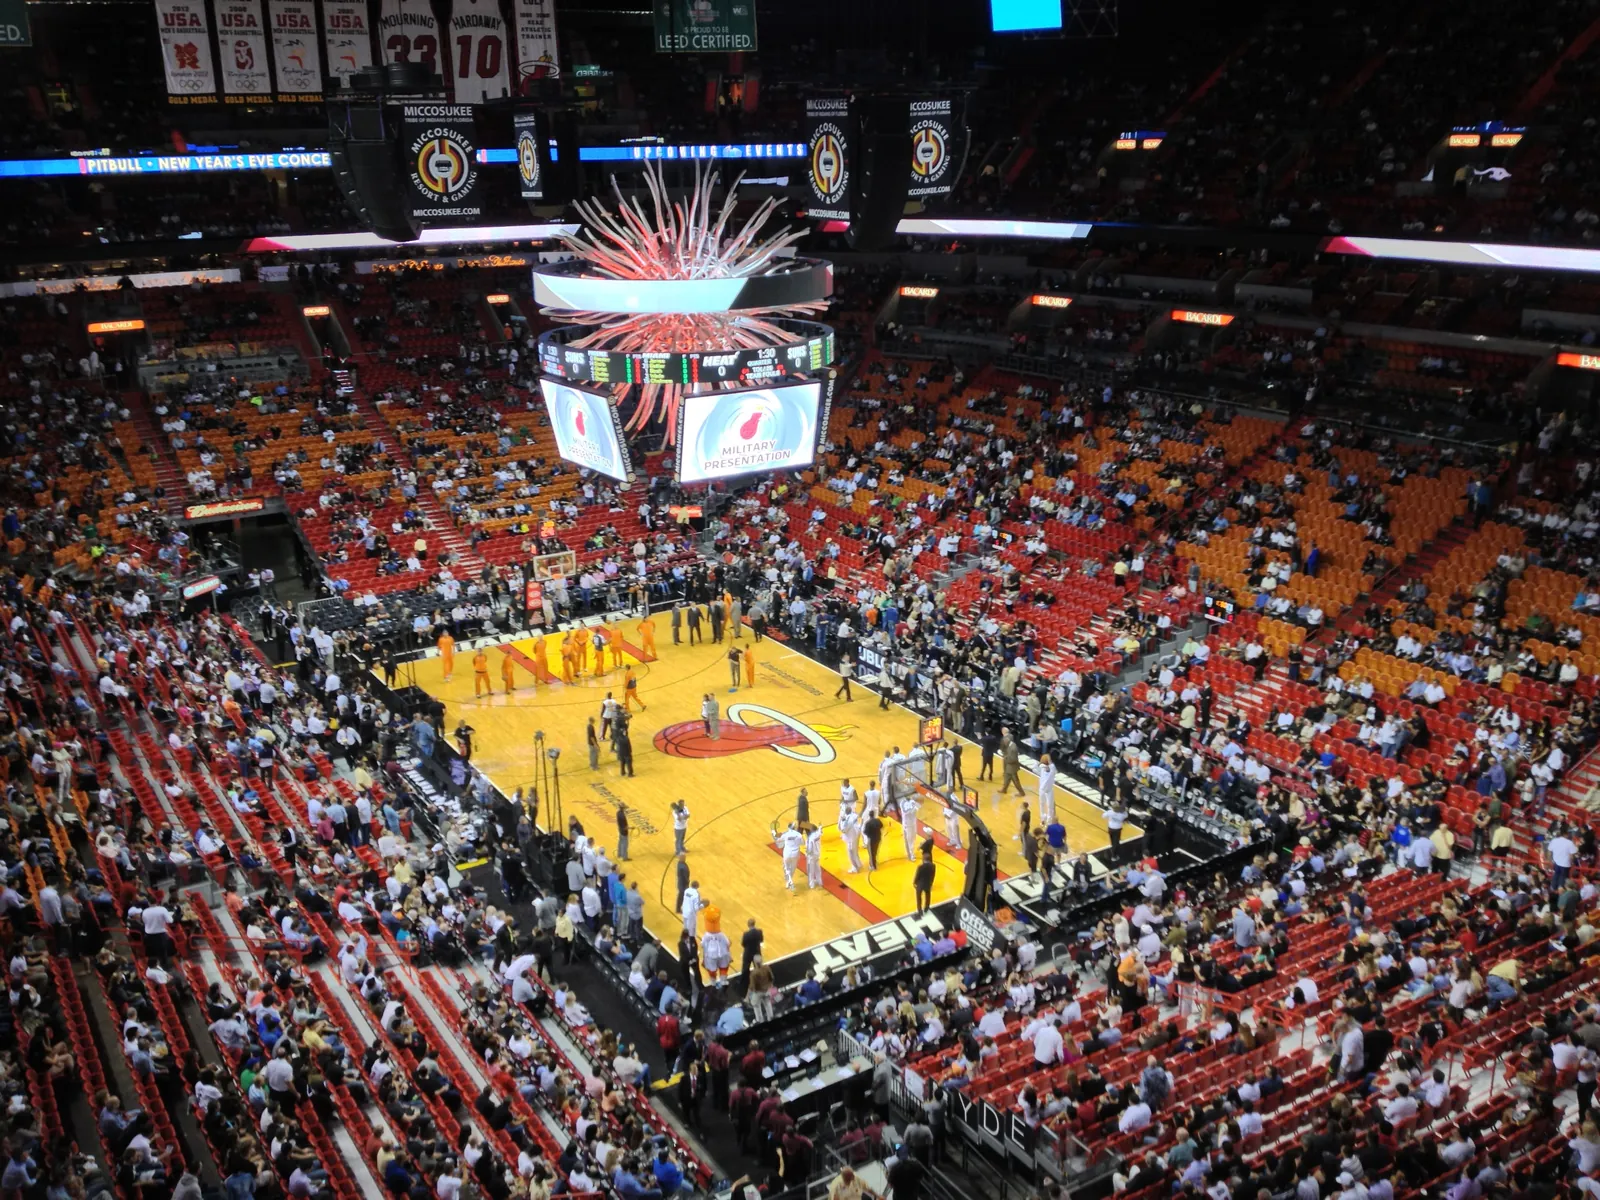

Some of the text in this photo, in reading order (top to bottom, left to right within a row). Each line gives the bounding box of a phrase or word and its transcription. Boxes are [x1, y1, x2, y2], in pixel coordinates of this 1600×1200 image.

[163, 13, 202, 27] USA
[222, 14, 257, 28] USA
[276, 14, 311, 28] USA
[329, 15, 364, 28] USA
[381, 14, 434, 29] MOURNING
[451, 14, 501, 30] HARDAWAY
[659, 34, 753, 48] LEED CERTIFIED.
[456, 35, 502, 78] 10
[168, 96, 218, 104] GOLD MEDAL
[225, 96, 273, 104] GOLD MEDAL
[278, 95, 324, 103] GOLD MEDAL
[806, 99, 848, 110] MICCOSUKEE
[910, 100, 950, 111] ICCOSUKEE
[404, 106, 472, 116] MICCOSUKEE
[809, 122, 848, 150] MICCOSUKEE
[910, 120, 949, 141] ICCOSUKEE
[411, 128, 474, 154] MICCOSUKEE
[633, 144, 804, 159] UPCOMING EVENTS
[88, 152, 330, 172] PITBULL NEW YEAR'S EVE CONCE
[930, 155, 950, 182] GAMING
[411, 171, 477, 203] RESORT & GAMING
[808, 170, 849, 204] RESORT & GAMING
[908, 186, 950, 196] ICCOSUKEE.COM
[413, 208, 480, 216] MICCOSUKEE.COM
[1186, 311, 1221, 325] BACARDI
[100, 321, 132, 330] BACARDI
[703, 352, 738, 366] HEAT
[758, 348, 776, 359] 1:30
[788, 345, 807, 360] SUNS
[572, 364, 579, 373] 0
[795, 358, 802, 368] 0
[718, 366, 726, 376] 0
[820, 379, 835, 445] MICCOSUKEE.COM
[611, 405, 633, 472] MICCOSUKEE.COM
[722, 440, 776, 456] MILITARY
[704, 450, 791, 471] PRESENTATION
[923, 726, 940, 742] 24
[960, 908, 995, 940] Office
[959, 919, 992, 950] DEPOT
[811, 909, 945, 984] HEAT
